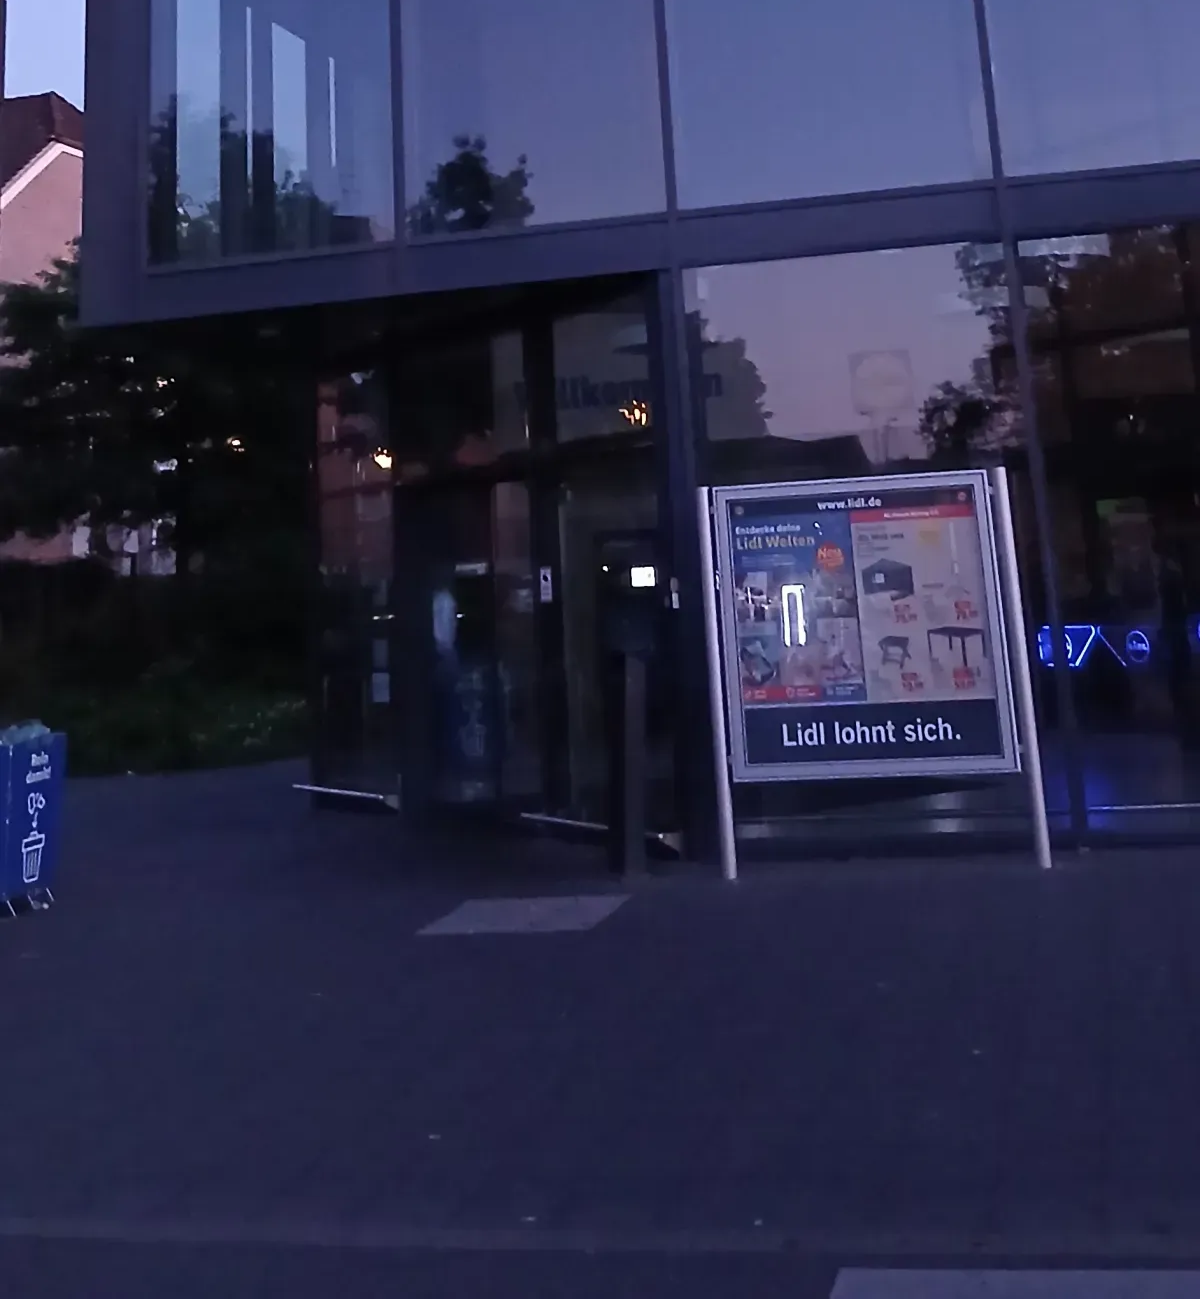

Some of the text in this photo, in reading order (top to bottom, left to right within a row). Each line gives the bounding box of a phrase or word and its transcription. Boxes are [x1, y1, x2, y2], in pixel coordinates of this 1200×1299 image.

[817, 497, 882, 511] www.lidl.de
[736, 534, 815, 550] Lidl Welten
[782, 717, 961, 747] Lidl lohnt sich.
